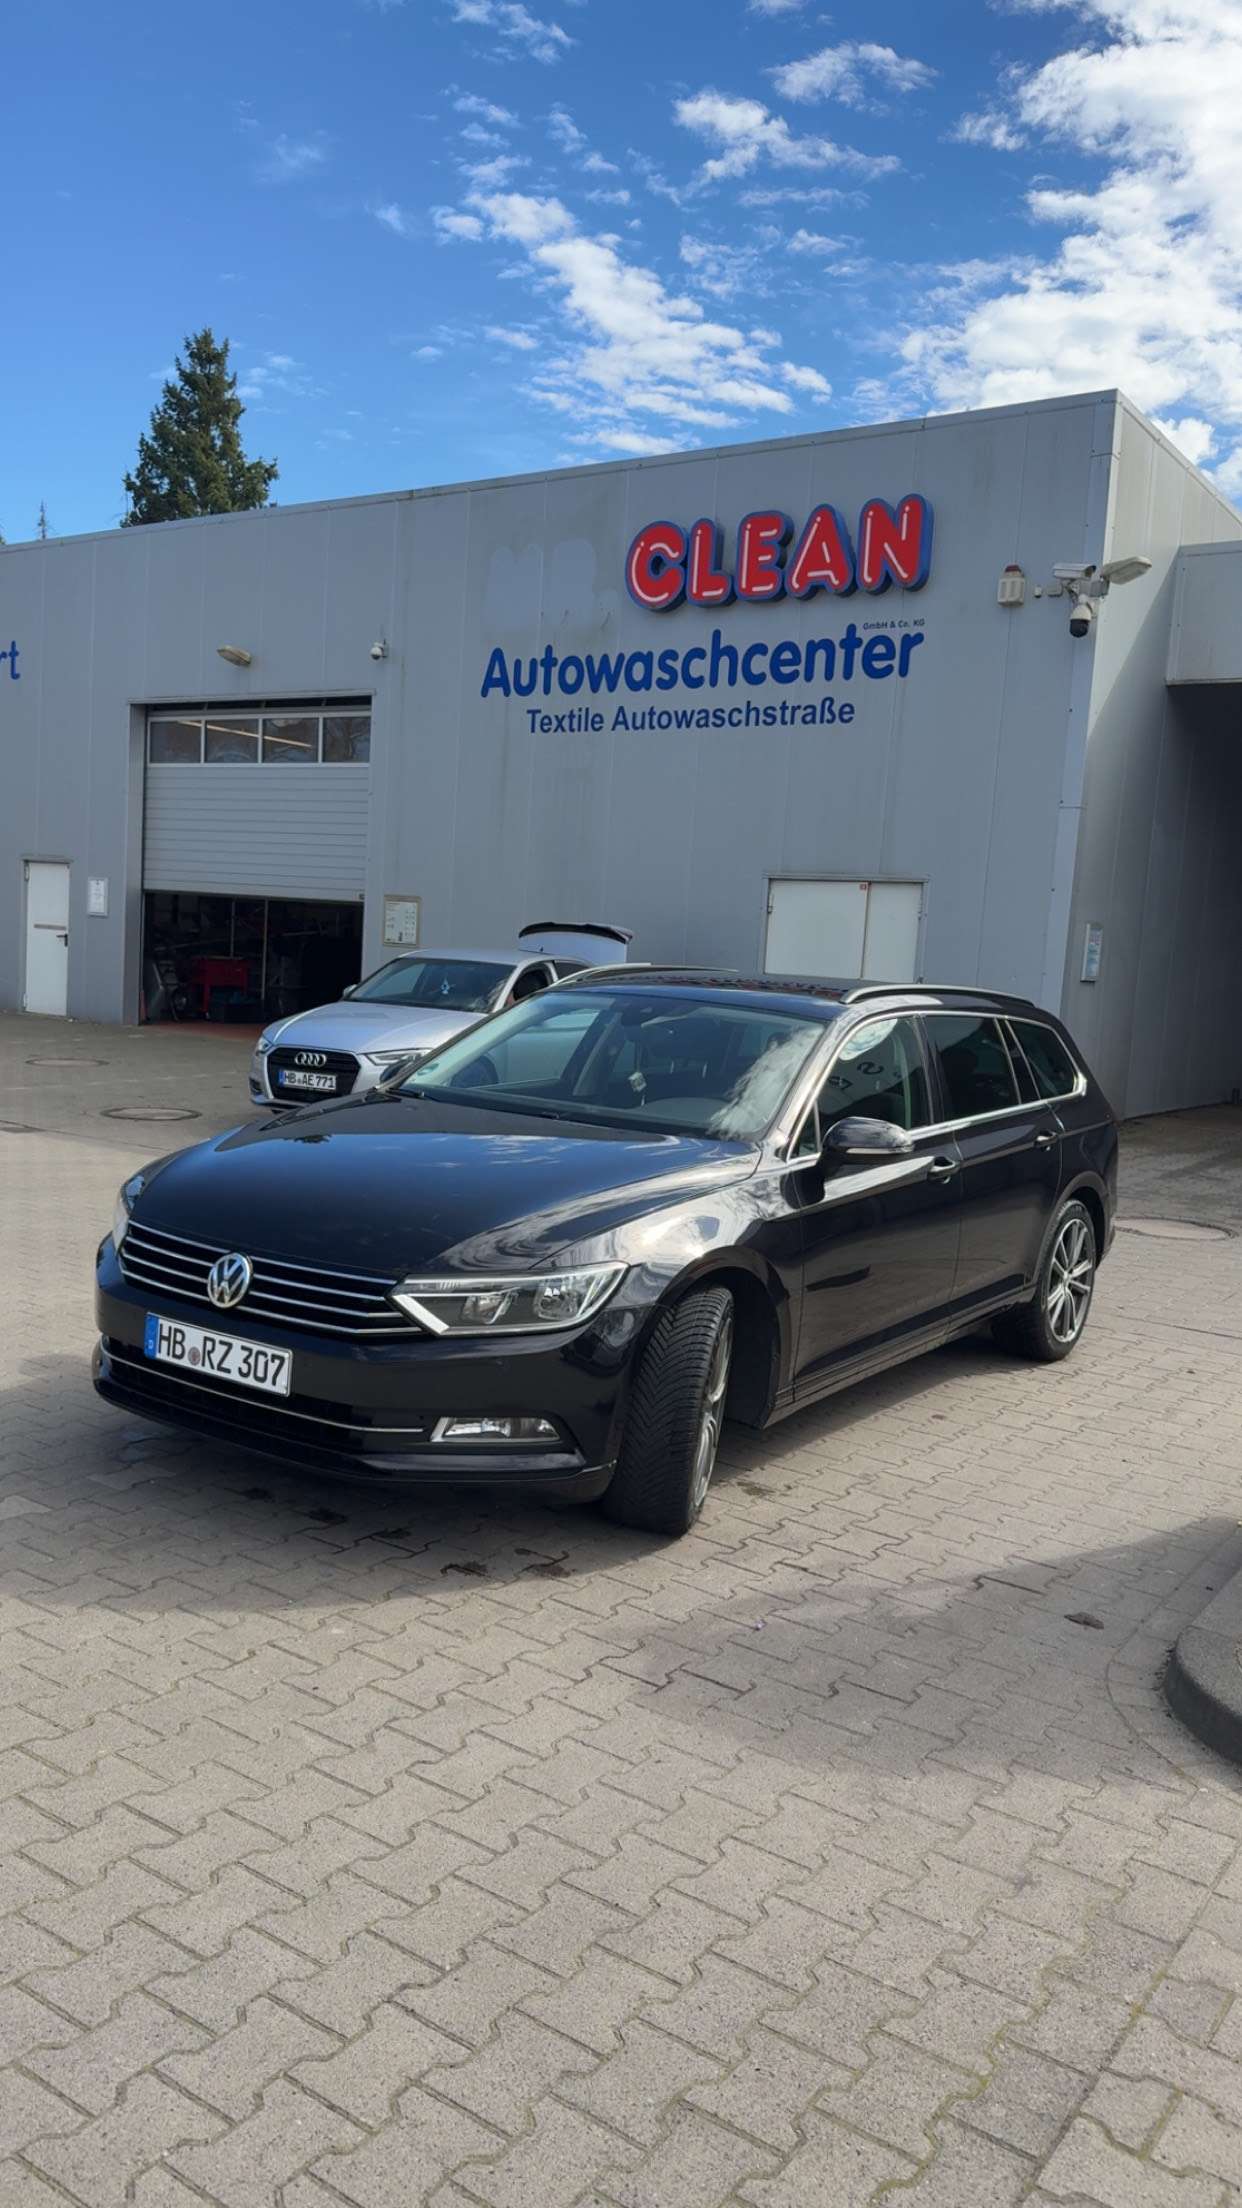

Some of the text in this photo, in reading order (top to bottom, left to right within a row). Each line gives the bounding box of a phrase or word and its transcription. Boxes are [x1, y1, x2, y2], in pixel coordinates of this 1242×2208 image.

[625, 493, 933, 612] CLEAN
[863, 622, 888, 630] GmbH
[889, 621, 896, 629] &
[913, 618, 925, 627] KG
[480, 623, 925, 698] Autowaschcenter
[526, 696, 856, 734] Textile Autowaschstraße
[285, 1071, 334, 1088] HB AE 771
[158, 1323, 285, 1386] HB RZ 307
